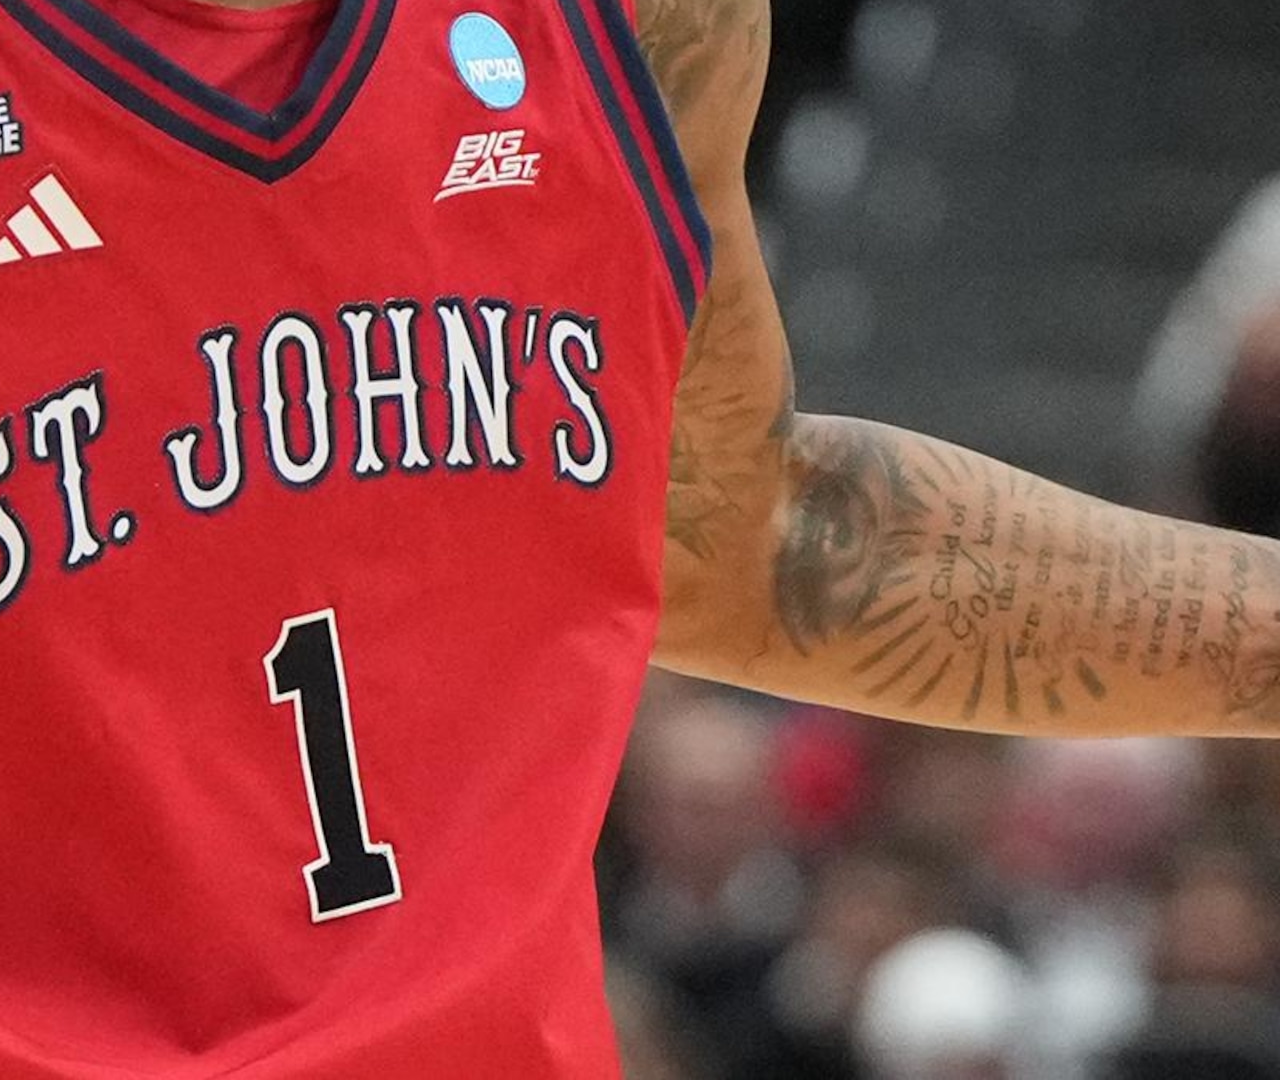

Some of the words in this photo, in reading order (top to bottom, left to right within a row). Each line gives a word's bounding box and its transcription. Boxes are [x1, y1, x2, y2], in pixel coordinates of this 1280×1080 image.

[466, 56, 521, 83] NCAA
[454, 129, 525, 162] BIG
[441, 153, 541, 187] EAST
[163, 297, 610, 514] JOHN'S
[262, 607, 404, 924] 1
